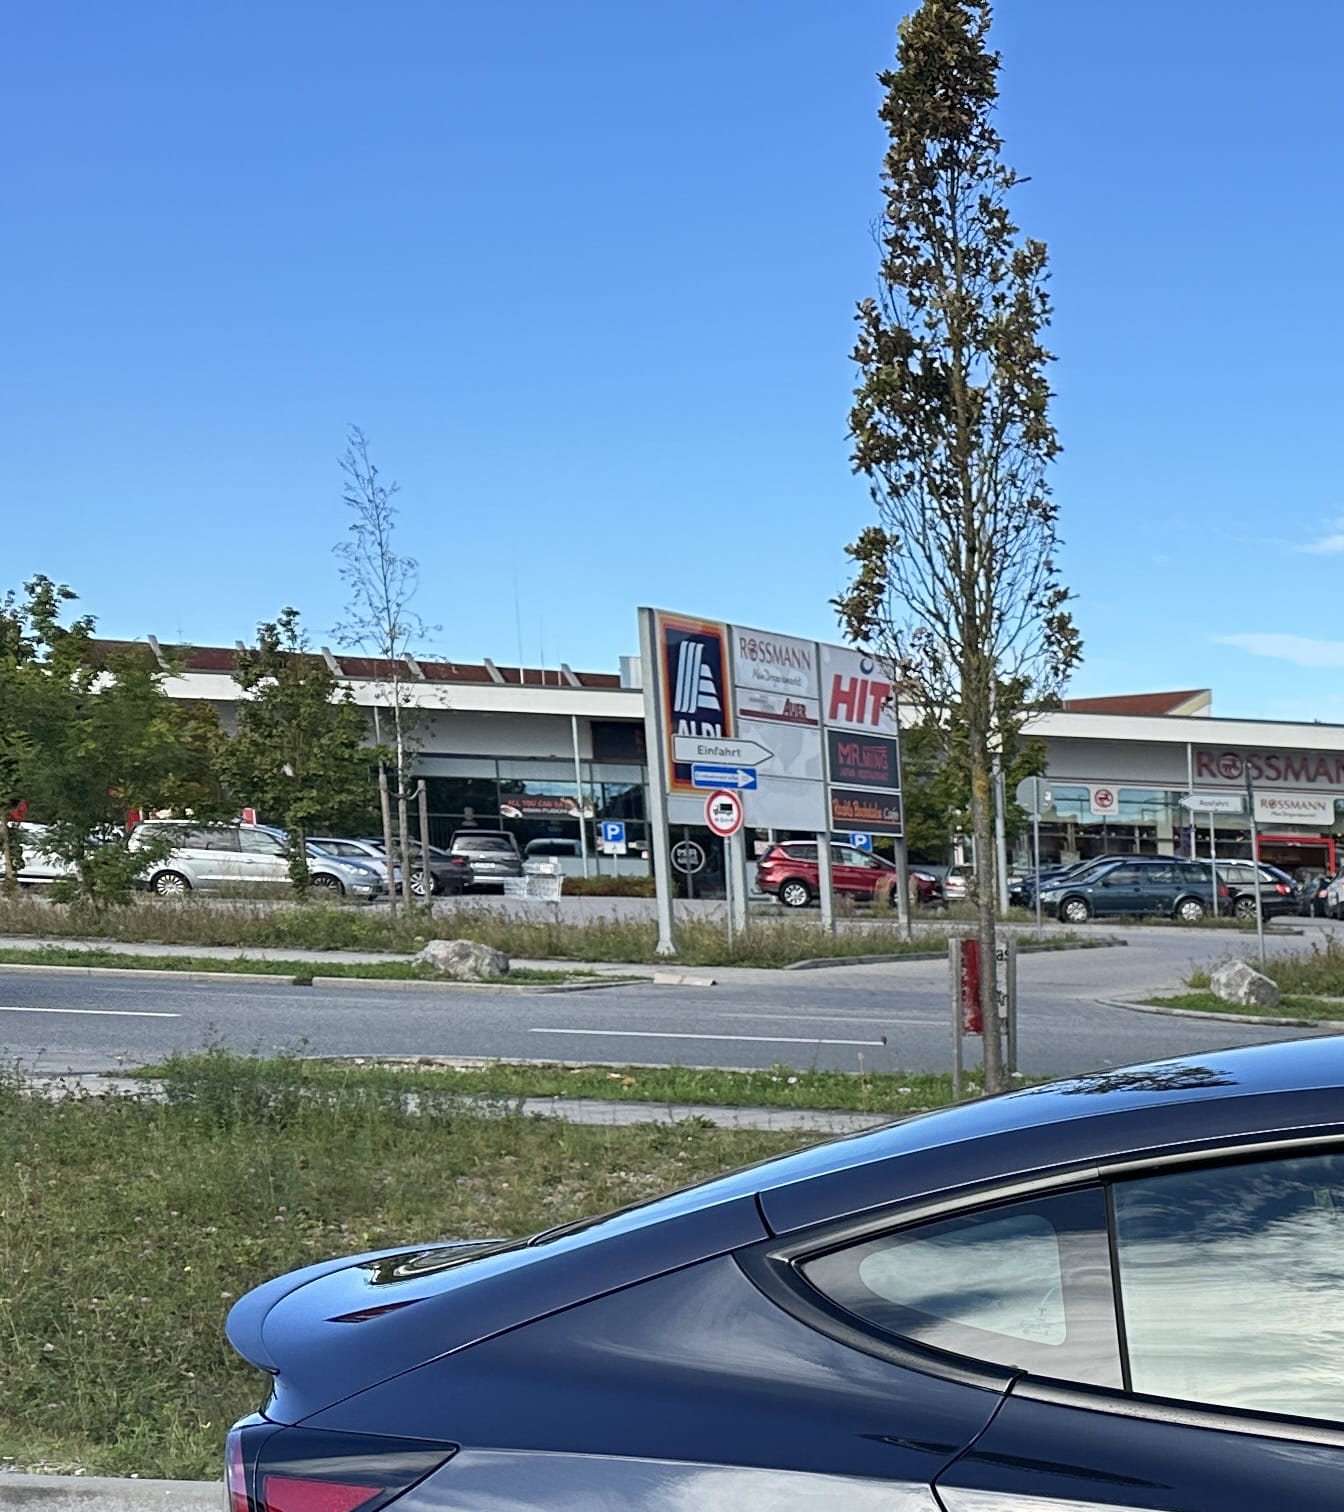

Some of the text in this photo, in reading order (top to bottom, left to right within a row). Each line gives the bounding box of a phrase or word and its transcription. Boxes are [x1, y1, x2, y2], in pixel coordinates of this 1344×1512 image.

[739, 637, 811, 671] ROSSMANN
[829, 674, 891, 726] HIT
[697, 745, 741, 758] Einfahrt
[1260, 799, 1327, 811] ROSSMANN
[607, 825, 620, 840] P
[855, 834, 867, 848] P
